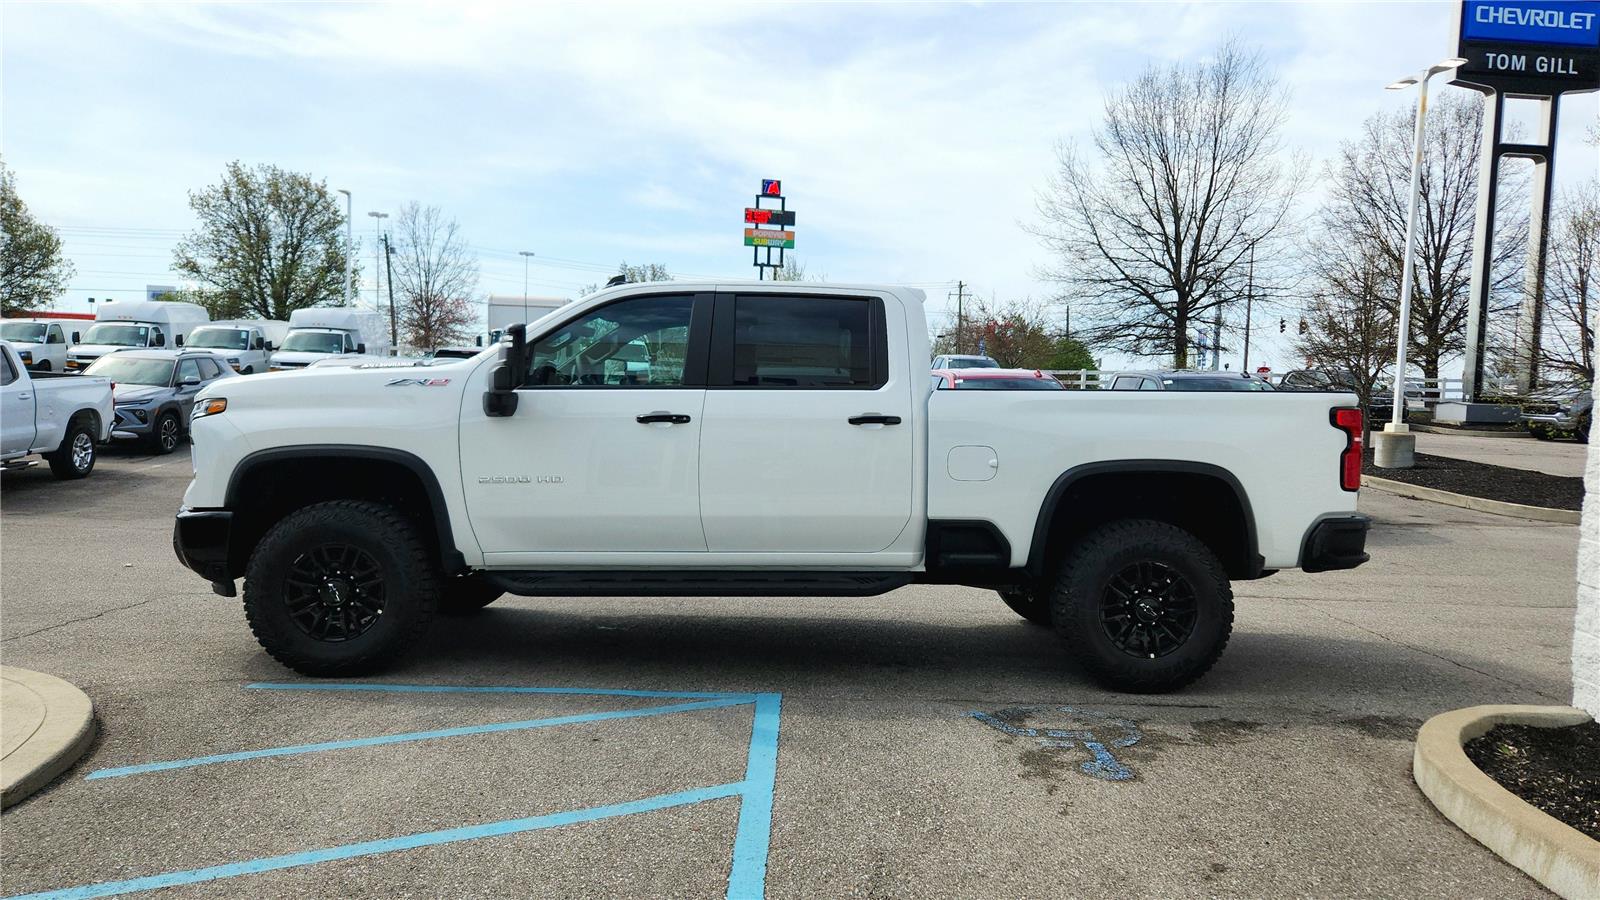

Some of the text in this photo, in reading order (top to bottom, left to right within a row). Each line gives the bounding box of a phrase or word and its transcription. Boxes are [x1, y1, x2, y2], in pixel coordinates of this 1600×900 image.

[1475, 5, 1596, 30] CHEVROLET
[1485, 52, 1578, 75] TOM GILL
[763, 180, 780, 194] TA
[752, 238, 786, 247] SUBWAY
[478, 475, 564, 484] 2500 HD
